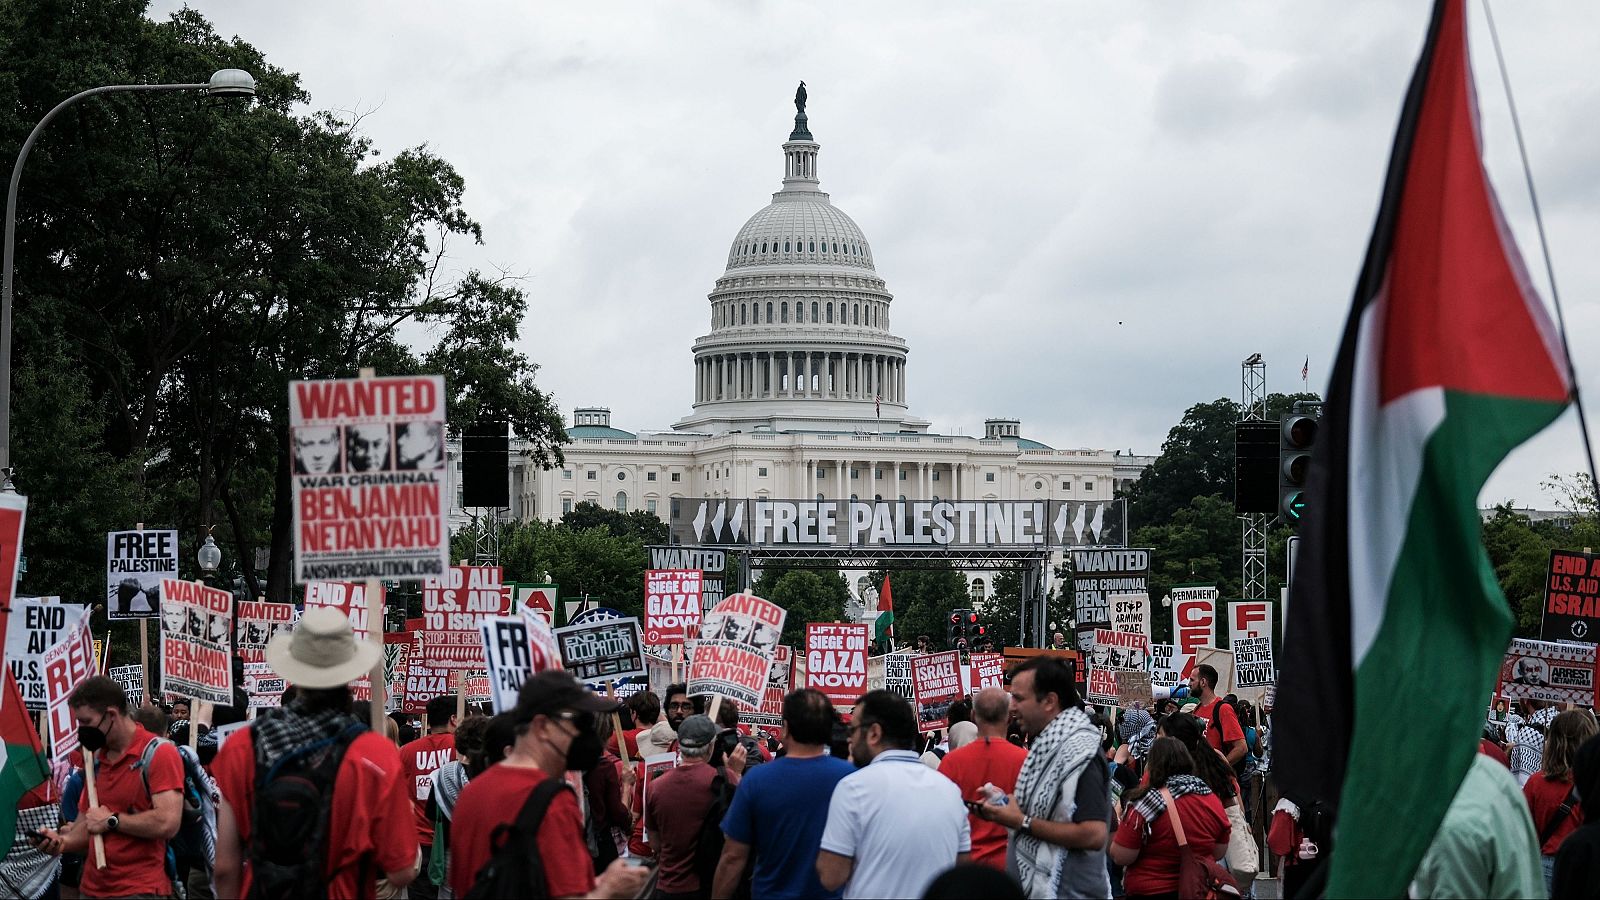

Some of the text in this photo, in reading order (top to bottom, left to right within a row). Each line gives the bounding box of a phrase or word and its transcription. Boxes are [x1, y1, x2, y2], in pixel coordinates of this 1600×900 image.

[296, 379, 437, 419] WANTED
[299, 472, 439, 488] WAR CRIMINAL
[299, 484, 439, 521] BENJAMIN
[755, 501, 1044, 545] FREE PALESTINE!
[301, 517, 441, 552] NETANYAHU
[114, 532, 171, 558] FREE
[110, 559, 175, 572] PALESTINE
[651, 548, 725, 572] WANTED
[1075, 551, 1148, 572] WANTED
[1552, 555, 1587, 576] END
[301, 559, 442, 579] ANSWERCOALITION.ORG
[675, 572, 700, 580] THE
[467, 568, 501, 589] ALL
[1075, 578, 1147, 591] WAR CRIMINAL
[1551, 575, 1599, 594] U.S. AID
[306, 582, 346, 606] END
[648, 581, 700, 594] SIEGE ON
[1173, 589, 1216, 600] PERMANENT
[163, 579, 229, 613] WANTED
[424, 590, 461, 612] U.S.
[466, 590, 501, 612] AID
[647, 594, 700, 616] GAZA
[26, 606, 66, 630] END
[424, 613, 444, 630] TO
[647, 616, 700, 628] NOW
[1115, 613, 1143, 623] ARMING
[425, 633, 444, 643] STOP
[447, 633, 460, 644] THE
[564, 634, 597, 646] END
[599, 629, 631, 641] THE
[809, 626, 865, 635] LIFT THE
[165, 632, 228, 653] WAR CRIMINAL
[809, 635, 865, 650] SIEGE ON
[1096, 630, 1148, 649] WANTED
[1234, 637, 1269, 647] STAND WITH
[164, 639, 228, 672] BENJAMIN
[566, 637, 634, 661] OCCUPATION
[720, 641, 769, 660] CRIMINAL
[1152, 645, 1173, 657] END
[1235, 644, 1270, 653] PALESTINE!
[1514, 641, 1539, 651] FROM
[1541, 643, 1558, 652] THE
[1561, 645, 1587, 656] RIVER
[46, 624, 93, 702] RED
[693, 645, 769, 676] BENJAMIN
[808, 650, 866, 673] GAZA
[914, 654, 955, 667] STOP ARMING
[978, 660, 995, 668] LIFT
[1153, 657, 1171, 669] ALL
[1236, 651, 1271, 663] END THE
[11, 660, 42, 681] U.S.
[111, 668, 129, 676] STAND
[164, 658, 229, 688] NETANYAHU
[887, 669, 902, 677] END
[915, 662, 957, 681] ISRAEL
[979, 665, 1002, 678] SIEGE
[1236, 662, 1272, 671] OCCUPATION
[1551, 667, 1591, 679] ARREST
[690, 662, 765, 691] NETANYAHU
[808, 673, 866, 688] NOW
[918, 676, 959, 691] & FUND OUR
[1091, 669, 1116, 682] BENJ
[1163, 671, 1178, 682] AID
[1237, 669, 1272, 683] NOW!
[1551, 676, 1591, 687] NETANYAHU!
[406, 676, 447, 692] GAZA
[1089, 681, 1119, 696] NETAN
[163, 681, 231, 704] ANSWERCOALITION.ORG
[688, 684, 758, 707] ANSWERCOALITION.ORG
[919, 686, 959, 699] COMMUNITIES
[1545, 692, 1561, 701] D.C.
[416, 748, 452, 770] UAW
